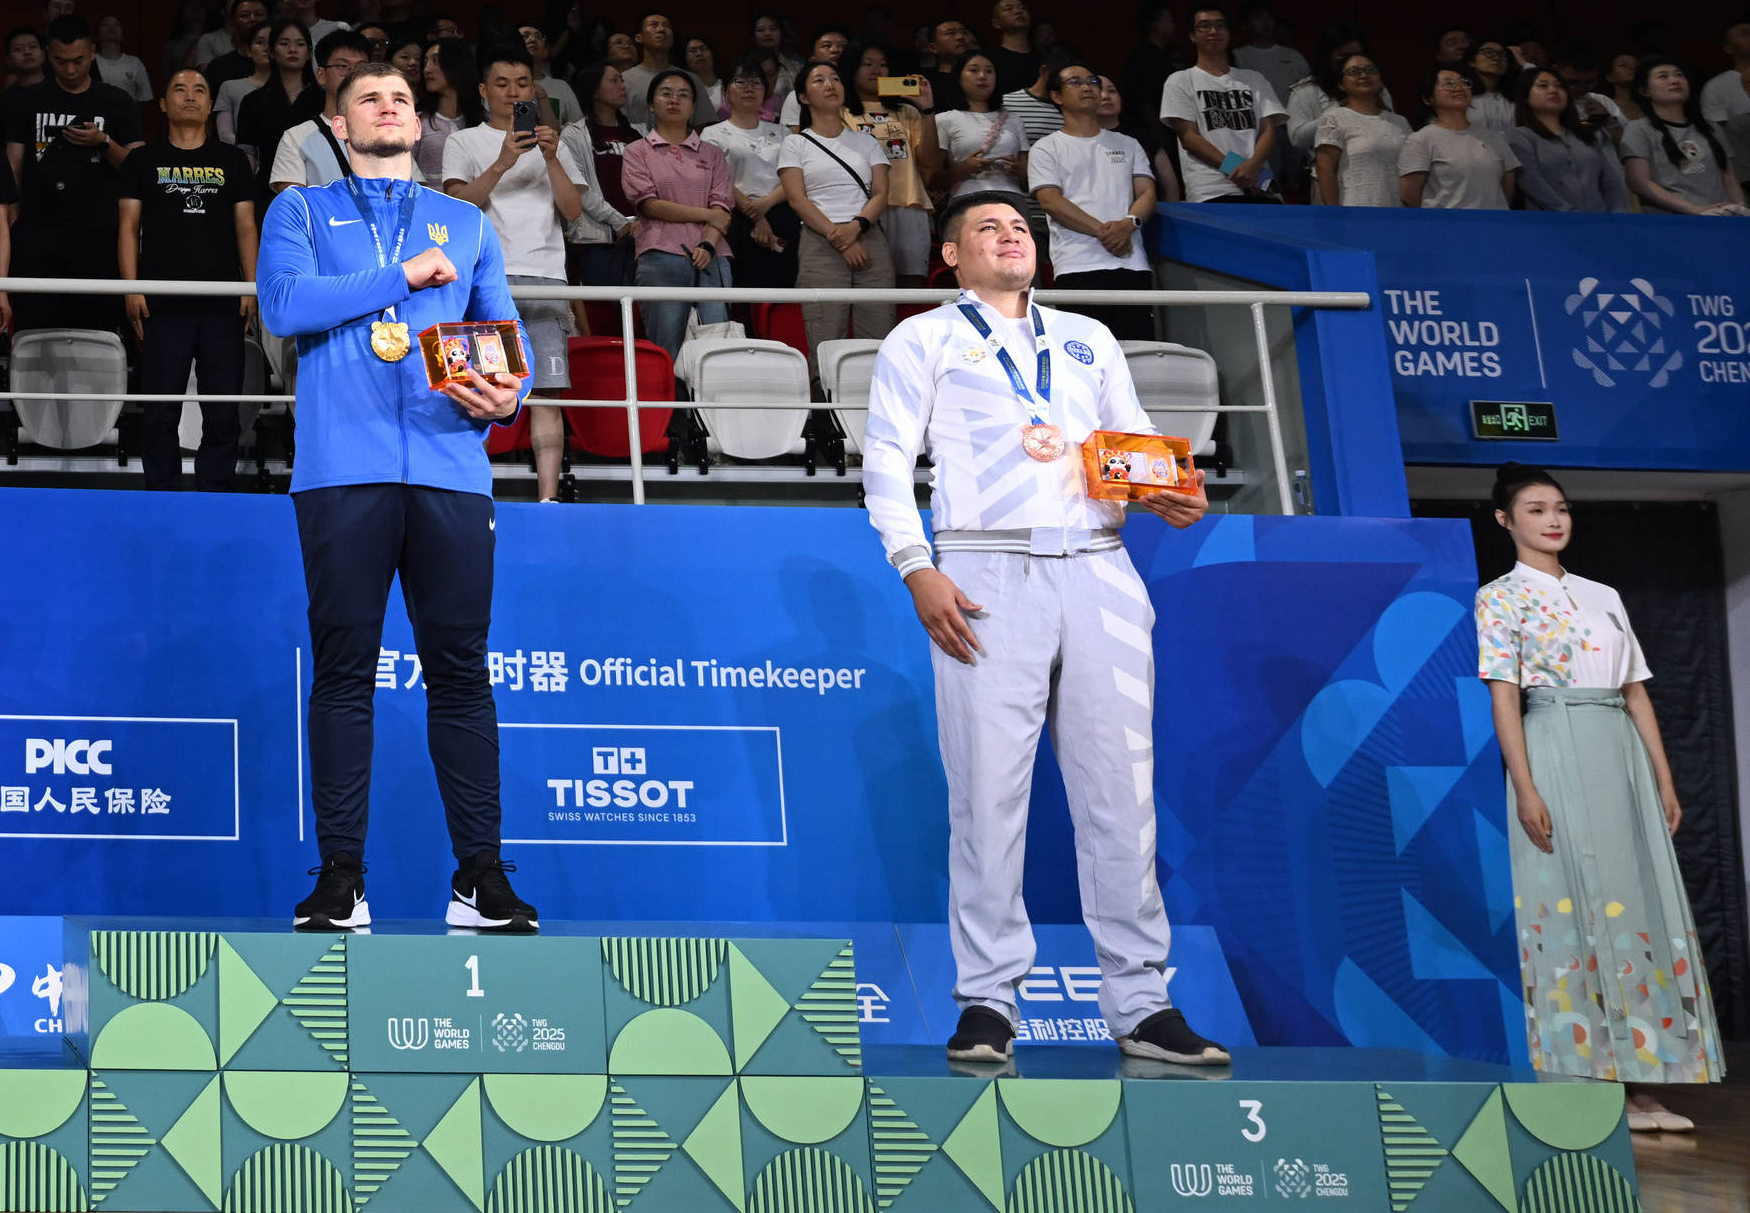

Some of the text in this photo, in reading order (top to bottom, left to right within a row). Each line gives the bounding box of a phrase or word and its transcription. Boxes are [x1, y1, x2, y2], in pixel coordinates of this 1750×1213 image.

[1384, 289, 1443, 316] THE
[1687, 294, 1734, 317] TWG
[1387, 319, 1500, 347] WORLD
[1394, 350, 1503, 378] GAMES
[1528, 415, 1548, 426] EXIT
[579, 658, 684, 688] Official
[691, 660, 866, 695] Timekeeper
[25, 737, 113, 775] PICC
[546, 779, 695, 809] TISSOT
[548, 811, 697, 823] SWISS WATCHES SINCE 1853
[464, 954, 485, 997] 1
[433, 1017, 453, 1028] THE
[532, 1018, 548, 1028] TWG
[433, 1028, 470, 1039] WORLD
[532, 1028, 566, 1041] 2025
[434, 1038, 470, 1050] GAMES
[532, 1041, 566, 1051] CHENGDU
[1238, 1099, 1267, 1143] 3
[1215, 1163, 1235, 1175] THE
[1313, 1163, 1329, 1173] TWG
[1217, 1175, 1254, 1186] WORLD
[1315, 1173, 1348, 1187] 2025
[1218, 1185, 1254, 1197] GAMES
[1315, 1187, 1349, 1197] CHENGDU
